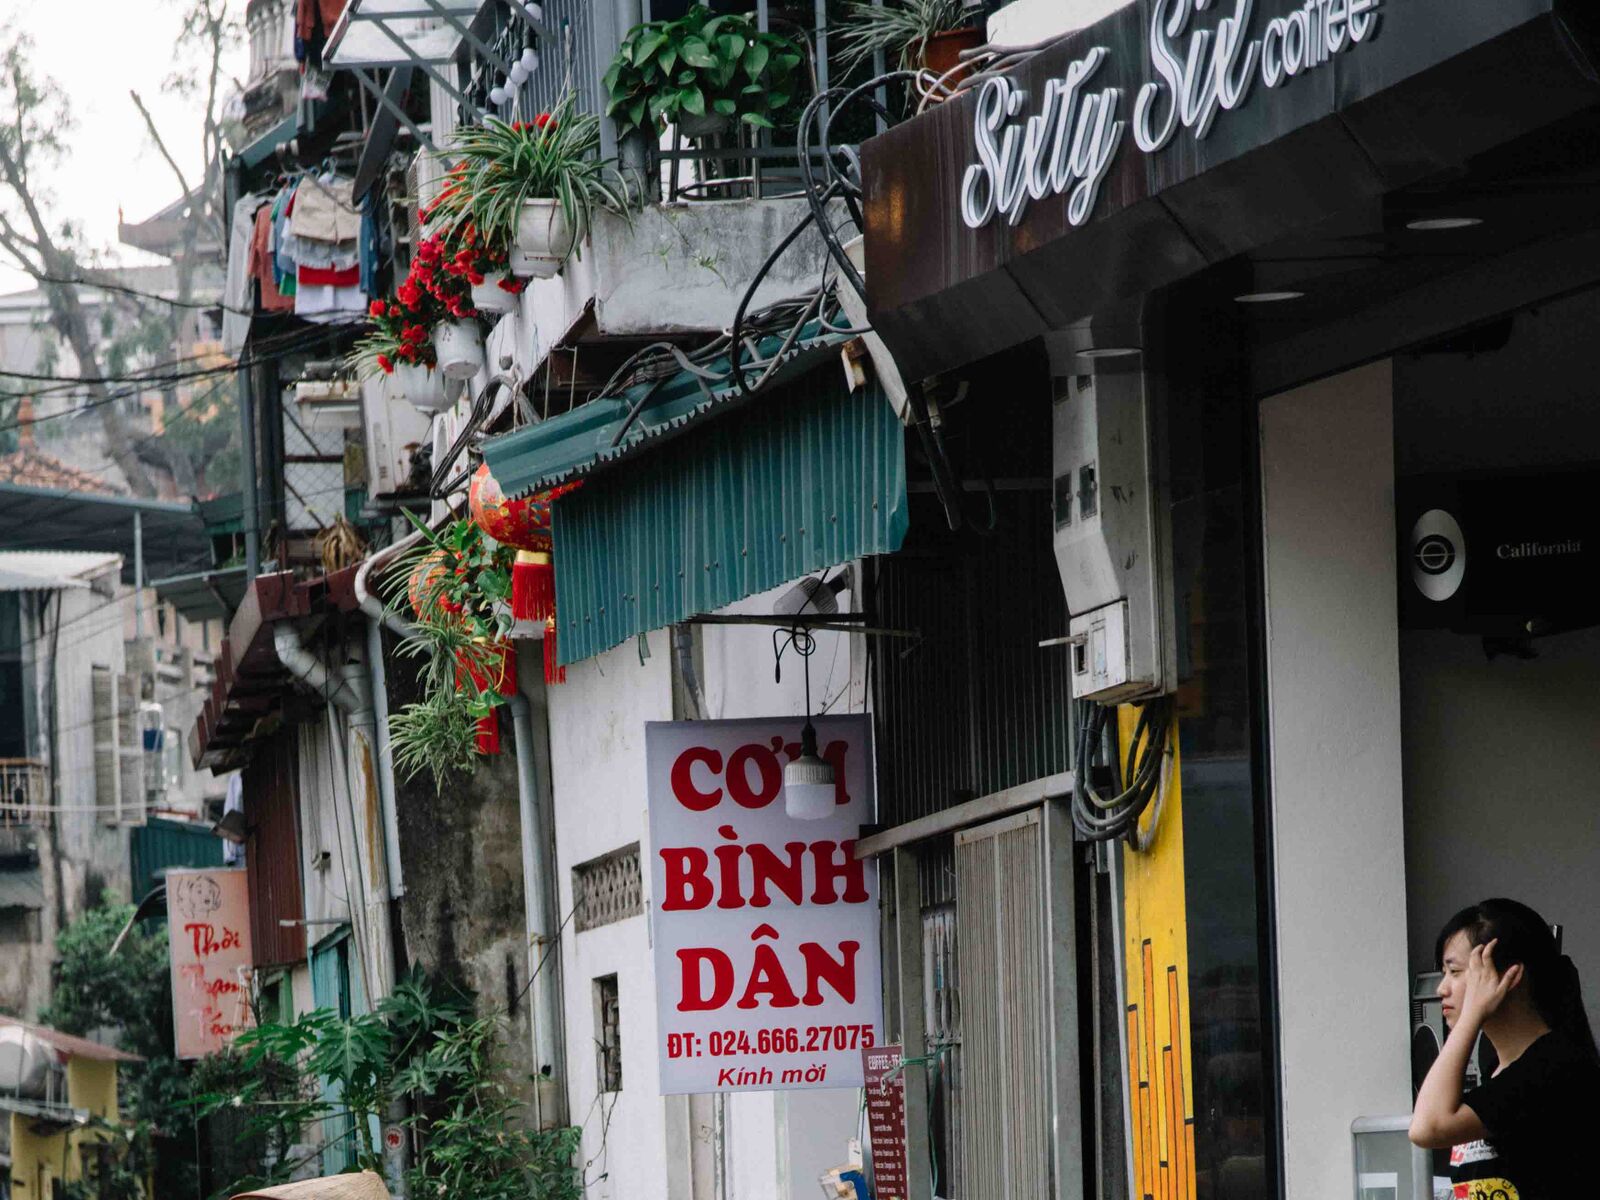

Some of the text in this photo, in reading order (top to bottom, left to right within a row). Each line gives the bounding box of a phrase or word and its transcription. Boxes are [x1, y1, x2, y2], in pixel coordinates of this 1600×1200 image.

[961, 0, 1379, 229] Sixty Six coffee
[1496, 539, 1582, 560] California
[659, 825, 870, 912] BÌNH
[184, 922, 242, 957] Thời
[676, 923, 861, 1012] DÂN
[667, 1023, 875, 1059] ĐT: 024.666.27075
[717, 1063, 828, 1087] Kính mời
